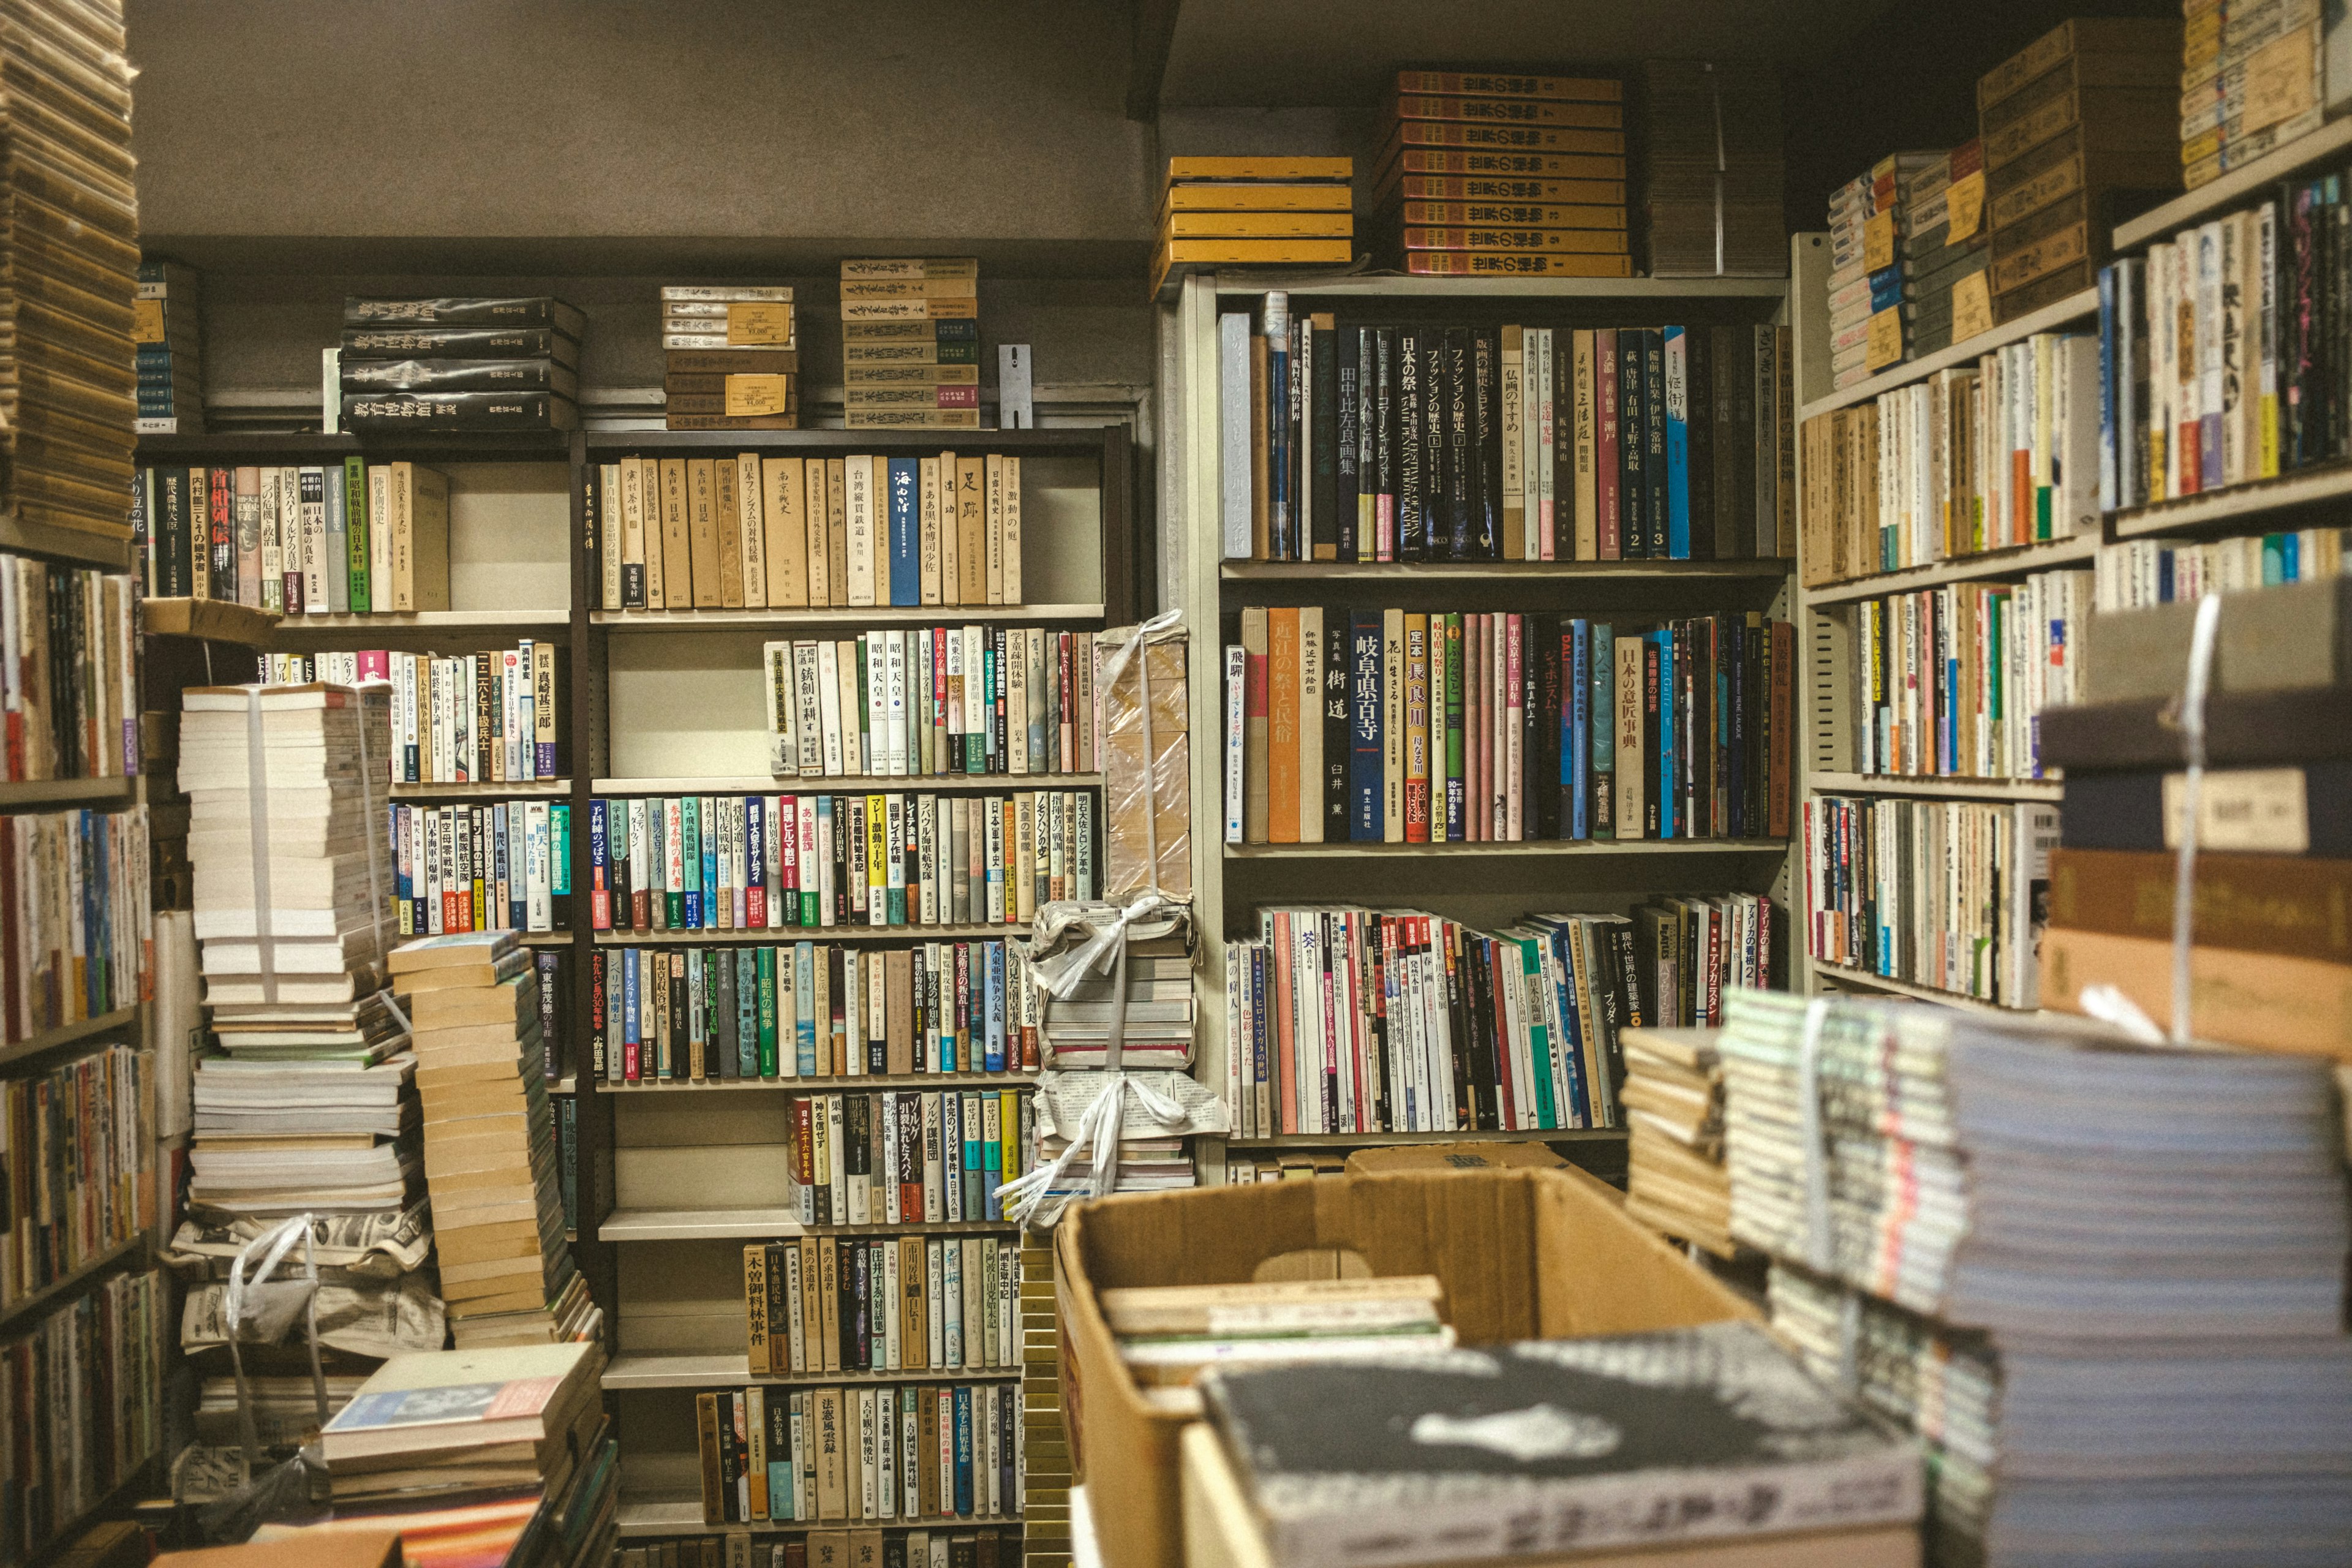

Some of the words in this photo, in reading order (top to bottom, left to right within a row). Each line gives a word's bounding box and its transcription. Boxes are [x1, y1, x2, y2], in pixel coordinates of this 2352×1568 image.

[1468, 181, 1542, 197] 世界の植物
[1469, 206, 1543, 222] 世界の植物
[1469, 231, 1543, 247] 世界の植物
[1472, 257, 1547, 272] 世界の植物
[1401, 338, 1416, 391] 日本の祭
[1758, 331, 1773, 373] さつき
[354, 402, 431, 417] 教育博物館
[1427, 350, 1440, 434] ファッションの歴史
[1452, 349, 1465, 433] ファッションの歴史
[1506, 369, 1518, 432] 仏画のすすめ
[1667, 375, 1684, 422] 姫街道
[1378, 398, 1390, 488] コマーシャルフォト
[166, 477, 178, 530] 歴代農林大臣
[210, 469, 229, 543] 首相列伝
[262, 475, 275, 547] 二つの危機と政治
[350, 480, 363, 553] 昭和戦前期の日本
[668, 468, 679, 522] 木戸幸一日記
[697, 468, 709, 522] 木戸幸一日記
[744, 462, 758, 564] 日本ファシズムの対外侵略
[778, 471, 791, 514] 南京戦史
[853, 470, 865, 536] 台湾縦貫鉄道
[894, 471, 912, 513] 海ゆかば
[960, 472, 978, 518] 足跡
[1007, 491, 1017, 541] 激動の庭
[192, 477, 206, 572] 内村鑑三とその継承者
[303, 507, 314, 565] 植民地の真実
[313, 506, 323, 534] 日本の
[924, 490, 937, 573] ああ黒木博司少佐
[1608, 533, 1616, 545] 1
[1630, 534, 1639, 546] 2
[1654, 533, 1664, 545] 3
[630, 568, 638, 598] 荒畑寒村
[522, 647, 530, 680] 満州事変
[539, 654, 549, 668] 評伝
[872, 644, 884, 697] 昭和天皇
[890, 644, 902, 696] 昭和天皇
[937, 633, 945, 693] 日本の名機百選
[951, 636, 960, 703] 板東俘虜収容所
[997, 643, 1005, 696] これが沖縄戦だ
[1010, 632, 1023, 688] 学童疎開体験
[1332, 630, 1341, 662] 写真集
[1411, 630, 1423, 658] 定本
[1433, 622, 1442, 677] 岐阜県の祭り
[1448, 645, 1460, 695] ふるさと
[1509, 624, 1519, 703] 平安京千二百年
[1562, 635, 1570, 661] DALI
[420, 679, 428, 734] 太平洋戦争前夜
[432, 665, 441, 726] 最終戦争論
[477, 655, 490, 751] 二・二六と下級兵士
[491, 676, 502, 736] 馬占山将軍伝
[538, 671, 551, 728] 真崎甚三郎
[1327, 669, 1348, 719] 街道
[1355, 636, 1379, 741] 岐阜県百寺
[1408, 662, 1425, 728] 長良川
[1545, 650, 1557, 709] ジャポニスム
[1621, 649, 1637, 748] 日本の意匠事典
[1414, 737, 1423, 774] 母なる川
[511, 807, 520, 843] 名艦物語
[592, 806, 603, 865] 予科練のつばさ
[612, 805, 622, 858] 学徒兵の精神誌
[652, 810, 662, 881] 最後のゼロファイター
[669, 804, 683, 888] 参謀本部の暴れ者
[733, 804, 743, 853] 将軍の遺言
[835, 800, 844, 862] 山本五十六の江田島生活
[853, 808, 864, 872] 連合艦隊始末記
[872, 798, 882, 871] マレー激動の十年
[890, 803, 900, 864] 回想レイテ作戦
[907, 801, 916, 845] レイテ決戦
[920, 801, 933, 880] ラバウル海軍航空隊
[991, 802, 1000, 867] 日本軍事史
[1020, 802, 1030, 852] 天皇の軍隊
[1037, 795, 1046, 860] ノモンハンの空
[1052, 796, 1063, 851] 指揮者の戦訓
[1065, 804, 1075, 875] 海軍と植物検疫
[1078, 796, 1088, 875] 明石大佐とロシア革命
[427, 819, 438, 884] 日本海軍の爆弾
[442, 823, 453, 879] 空母零戦隊
[459, 823, 469, 883] 続・艦隊航空隊
[527, 833, 536, 875] 賭けた青春
[1660, 924, 1669, 960] BEATLES
[1745, 905, 1755, 965] アメリカの看板
[657, 960, 666, 1014] 北京収容所
[816, 951, 827, 1001] 金太と兵隊
[914, 954, 923, 1007] 最後の特攻隊員
[958, 948, 968, 1005] 近衛兵の叛乱
[992, 945, 1001, 1023] 大東亜戦争の大義
[1008, 948, 1019, 1033] 私の見た南京事件
[1227, 949, 1238, 1009] 虹の狩人
[1423, 956, 1433, 982] 春画
[1435, 963, 1447, 1009] 川合玉堂展
[1621, 932, 1640, 1011] 現代・世界の建築家
[1708, 953, 1719, 1014] アフガニスタン
[1746, 967, 1754, 978] 2
[627, 981, 635, 1022] シベリヤ物語
[761, 979, 773, 1029] 昭和の戦争
[928, 971, 938, 1028] 特攻の町・知覧
[1529, 978, 1542, 1023] 日本の陶磁
[1540, 954, 1555, 1040] 新・カラーイメージ事典
[594, 1036, 604, 1071] 小野田寛郎
[1242, 1009, 1253, 1067] 色彩のうた
[1256, 999, 1266, 1079] ヒロ・ヤマガタの世界
[815, 1102, 825, 1148] 神を信ぜず
[831, 1101, 842, 1126] 巣鴨
[927, 1100, 938, 1161] ゾルゲ謀略団
[946, 1098, 957, 1173] 未完のゾルゲ事件
[1023, 1098, 1031, 1140] 夜明けの潮
[801, 1110, 810, 1178] 日本二千六百年史
[899, 1103, 911, 1180] 引裂かれたスパイ
[805, 1247, 815, 1292] 炎の求道者
[823, 1246, 834, 1291] 炎の求道者
[858, 1248, 867, 1300] 常紋トンネル
[872, 1250, 883, 1332] 住井すゑ対話集
[908, 1245, 918, 1283] 市川房枝
[931, 1250, 941, 1300] 受難の手記
[948, 1249, 959, 1299] 冤罪に抗して
[1000, 1253, 1009, 1300] 網走獄中記
[747, 1257, 766, 1346] 木曽御料林事件
[910, 1298, 919, 1317] 自伝
[875, 1338, 881, 1348] 2
[774, 1408, 783, 1445] 日本の名著
[862, 1399, 873, 1465] 天皇観の戦後史
[958, 1394, 969, 1462] 日本学と世界革命
